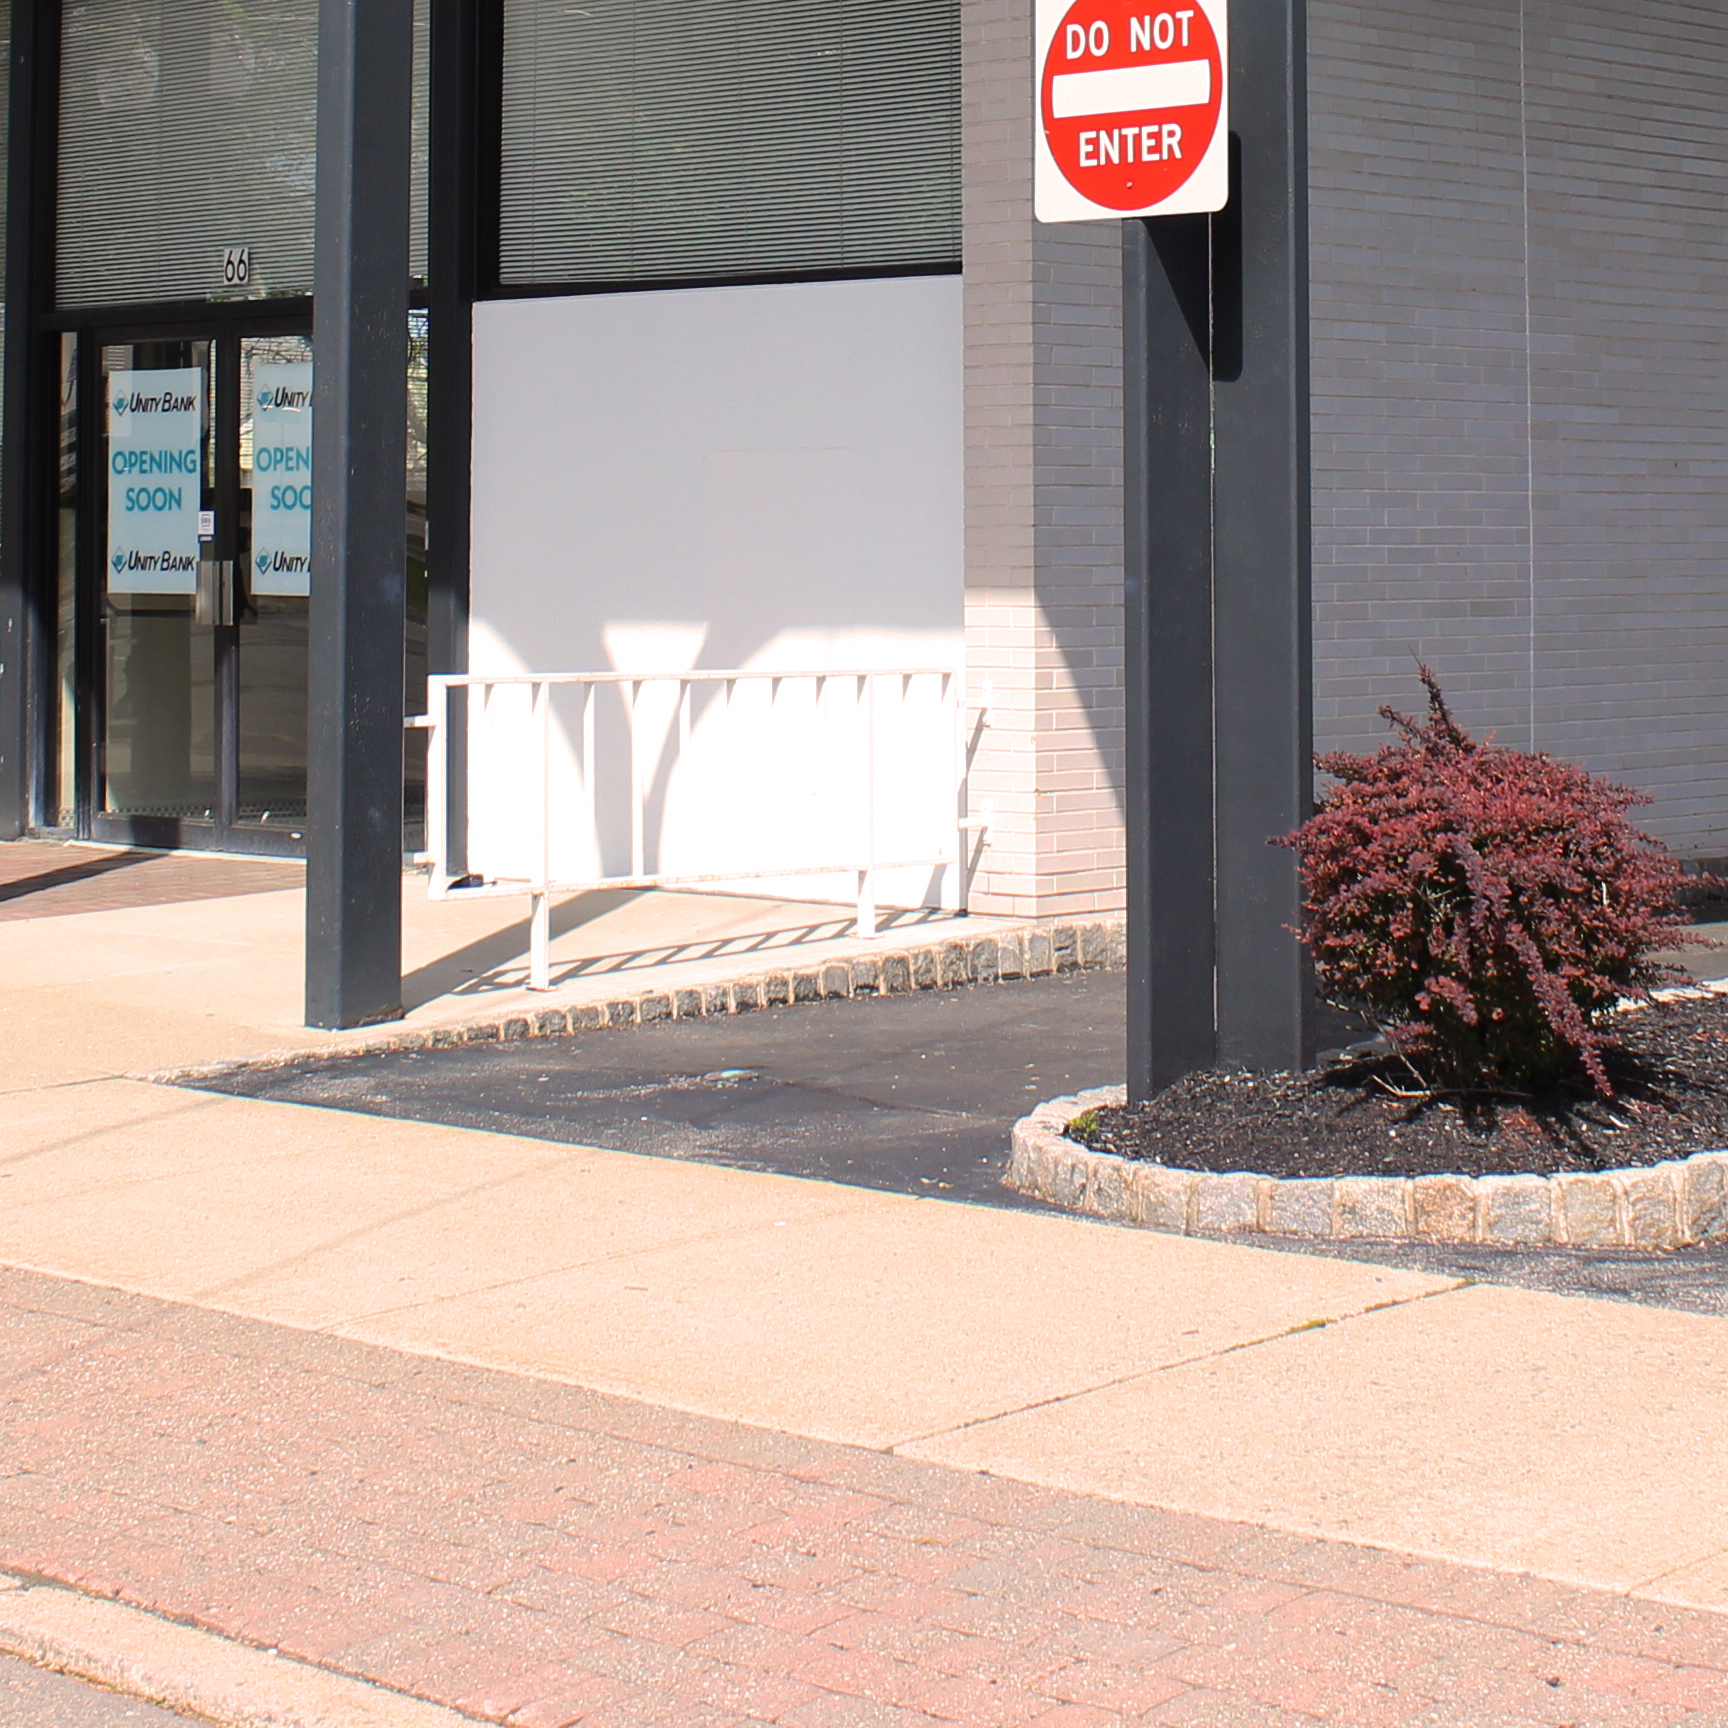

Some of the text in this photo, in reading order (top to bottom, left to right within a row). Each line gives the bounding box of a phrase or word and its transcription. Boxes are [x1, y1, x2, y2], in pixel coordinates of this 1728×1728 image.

[1065, 9, 1195, 60] DO NOT
[1078, 123, 1183, 168] ENTER
[224, 248, 248, 282] 66
[111, 449, 198, 475] OPENING
[256, 446, 311, 473] OPEN
[125, 486, 183, 512] SOON
[270, 485, 312, 511] SOO
